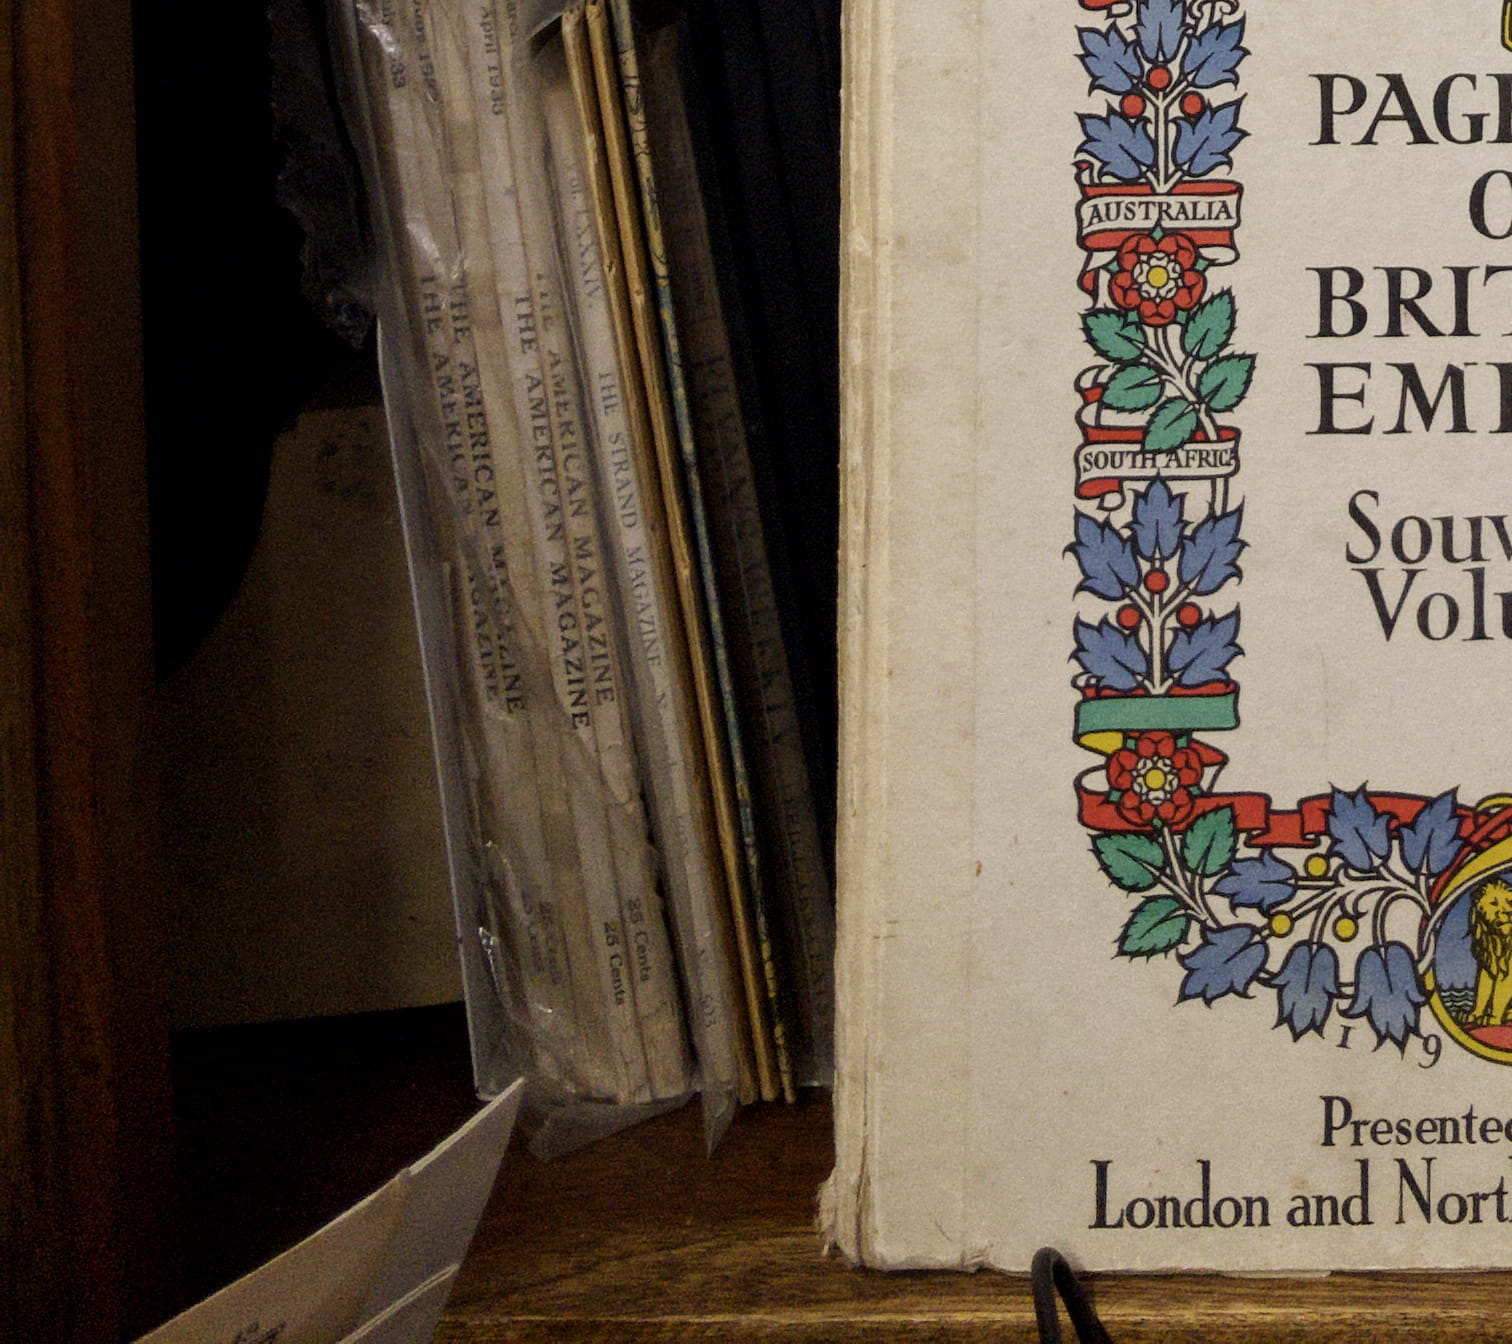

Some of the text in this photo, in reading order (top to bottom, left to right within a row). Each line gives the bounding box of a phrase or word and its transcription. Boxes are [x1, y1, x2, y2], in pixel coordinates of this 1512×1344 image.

[1087, 199, 1235, 227] AUSTRALIA
[459, 362, 500, 529] AMERICAN
[1083, 448, 1158, 474] SOUTH
[514, 294, 592, 731] THE AMERICAN MAGAZINE
[547, 349, 587, 519] AMERICAN
[574, 535, 616, 708] MAGAZINE
[598, 372, 662, 667] THE STRAND MAGAZINE
[466, 557, 500, 705] AGAZINE
[609, 953, 626, 1006] Cents
[634, 930, 651, 983] Cents
[1088, 1159, 1268, 1233] London
[1286, 1158, 1371, 1228] and
